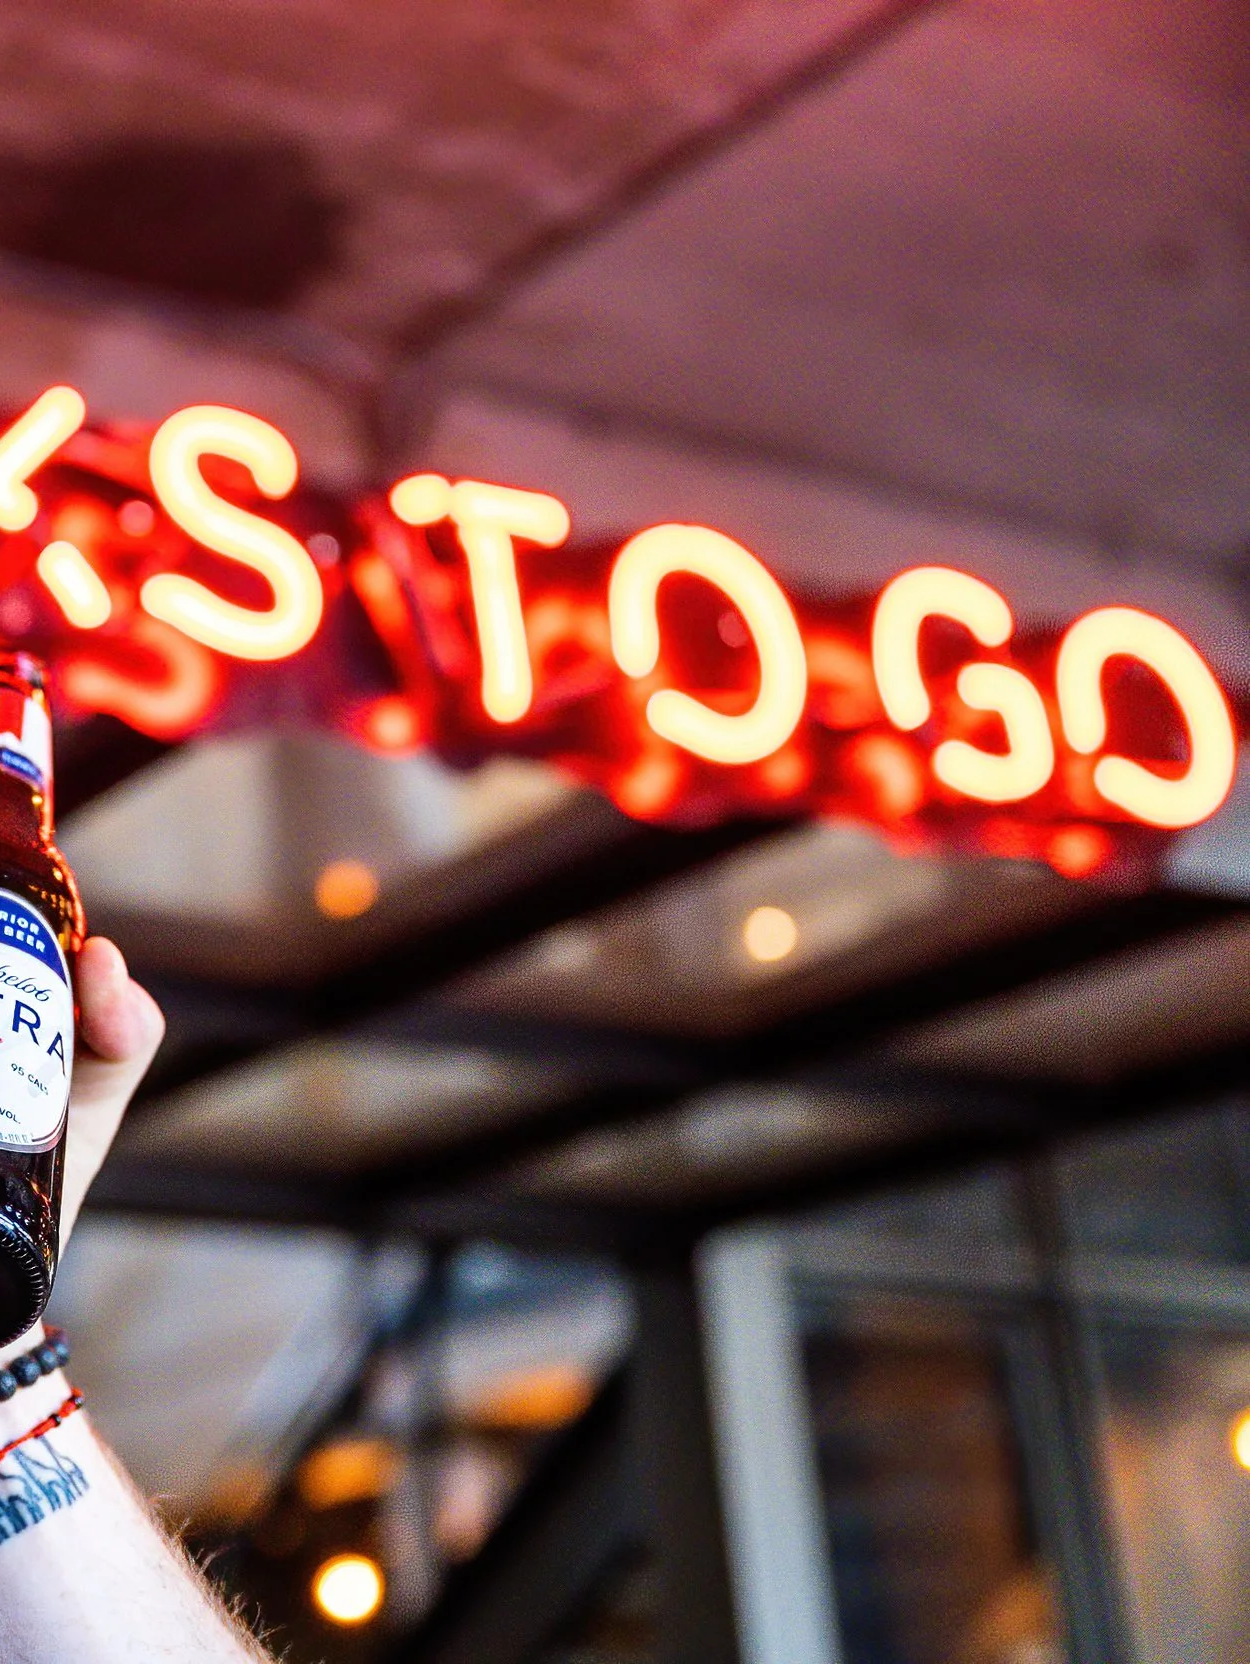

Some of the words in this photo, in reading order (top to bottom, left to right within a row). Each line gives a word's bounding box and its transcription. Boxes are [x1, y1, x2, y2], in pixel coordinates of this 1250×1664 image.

[389, 472, 807, 764] TO
[872, 566, 1235, 828] GO
[4, 926, 46, 953] BEER
[11, 1063, 25, 1076] 95
